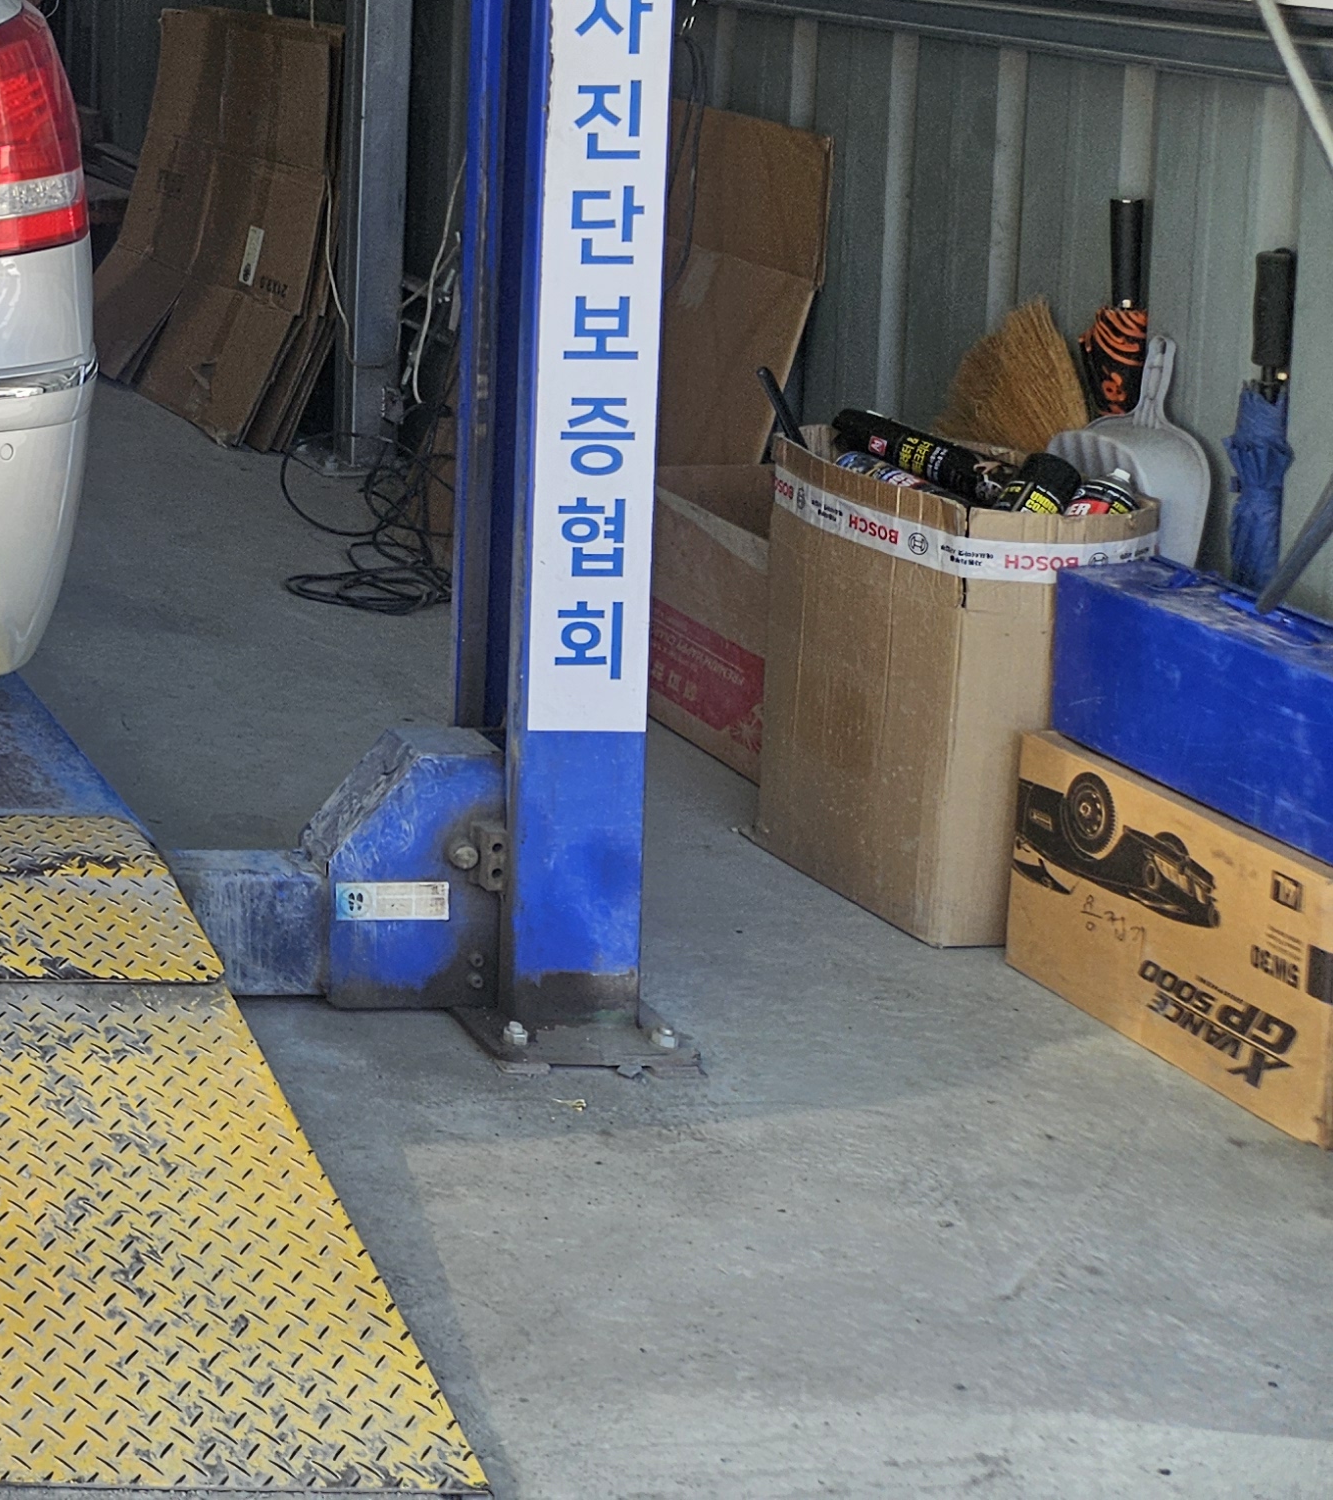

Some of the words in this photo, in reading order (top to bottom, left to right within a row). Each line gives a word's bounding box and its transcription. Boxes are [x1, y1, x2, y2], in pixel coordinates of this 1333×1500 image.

[774, 479, 794, 500] BOS
[849, 514, 899, 545] BOSCH
[1004, 554, 1080, 571] BOSCH
[1138, 959, 1217, 1015] 5000
[1216, 1002, 1298, 1055] GP
